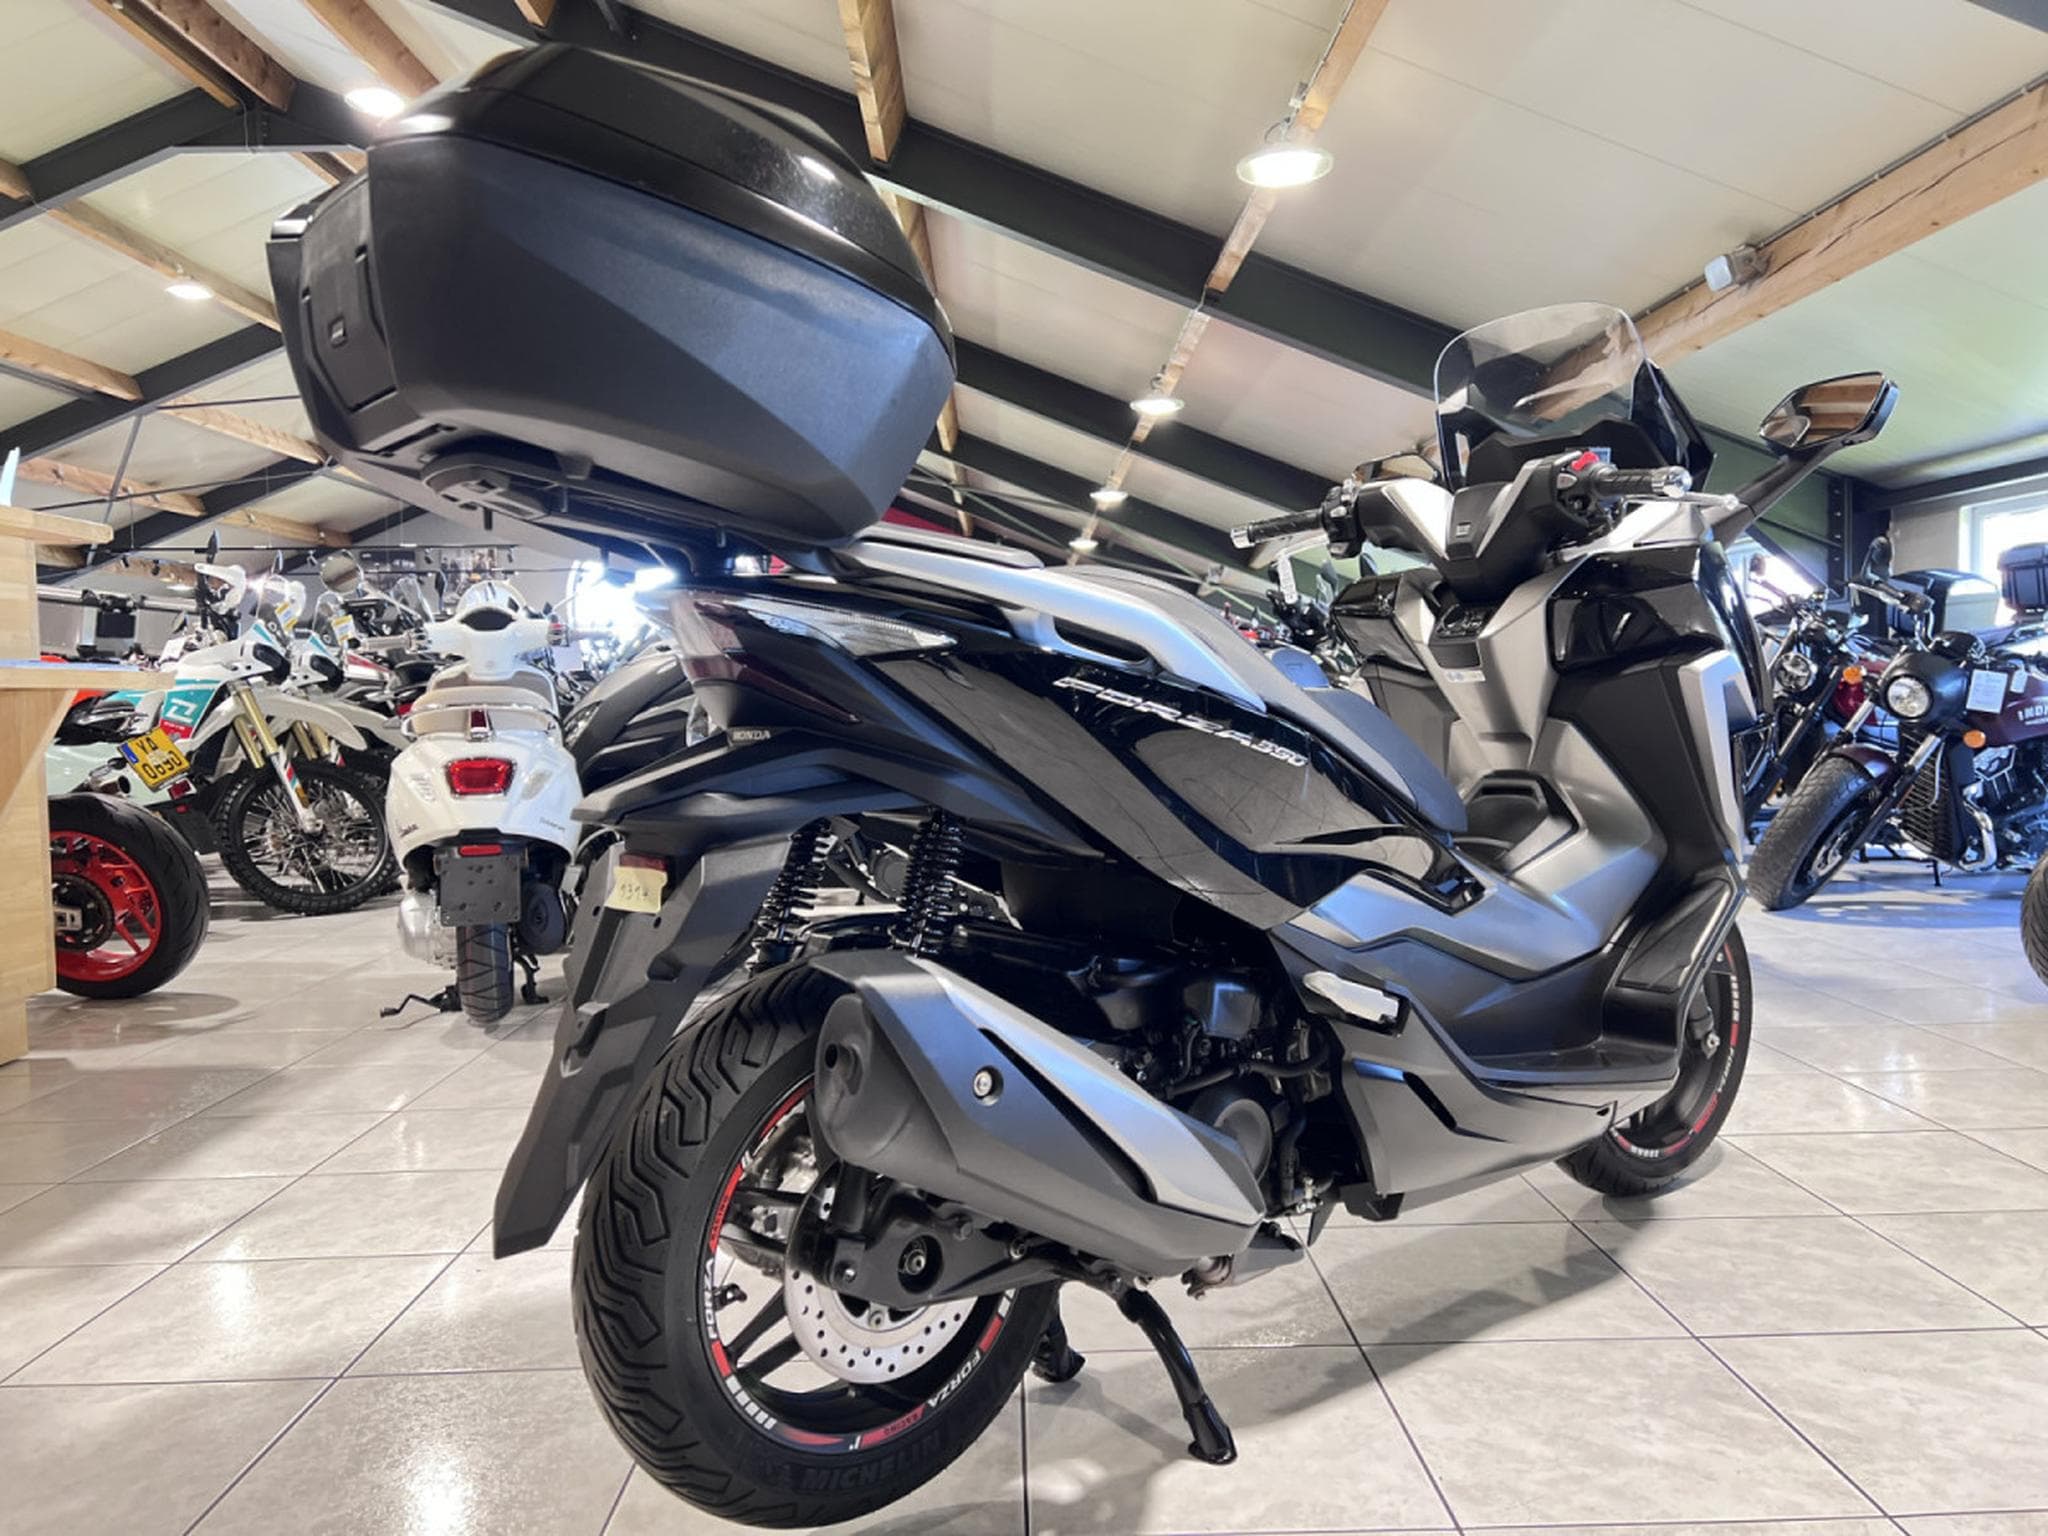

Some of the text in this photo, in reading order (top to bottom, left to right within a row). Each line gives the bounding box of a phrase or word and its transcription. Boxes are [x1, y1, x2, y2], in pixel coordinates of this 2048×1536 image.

[732, 730, 770, 740] HONDA
[1053, 677, 1309, 767] FORZA 350
[704, 1257, 718, 1339] FORZA
[928, 1349, 981, 1407] FORZA
[803, 1435, 941, 1491] MICHELIN
